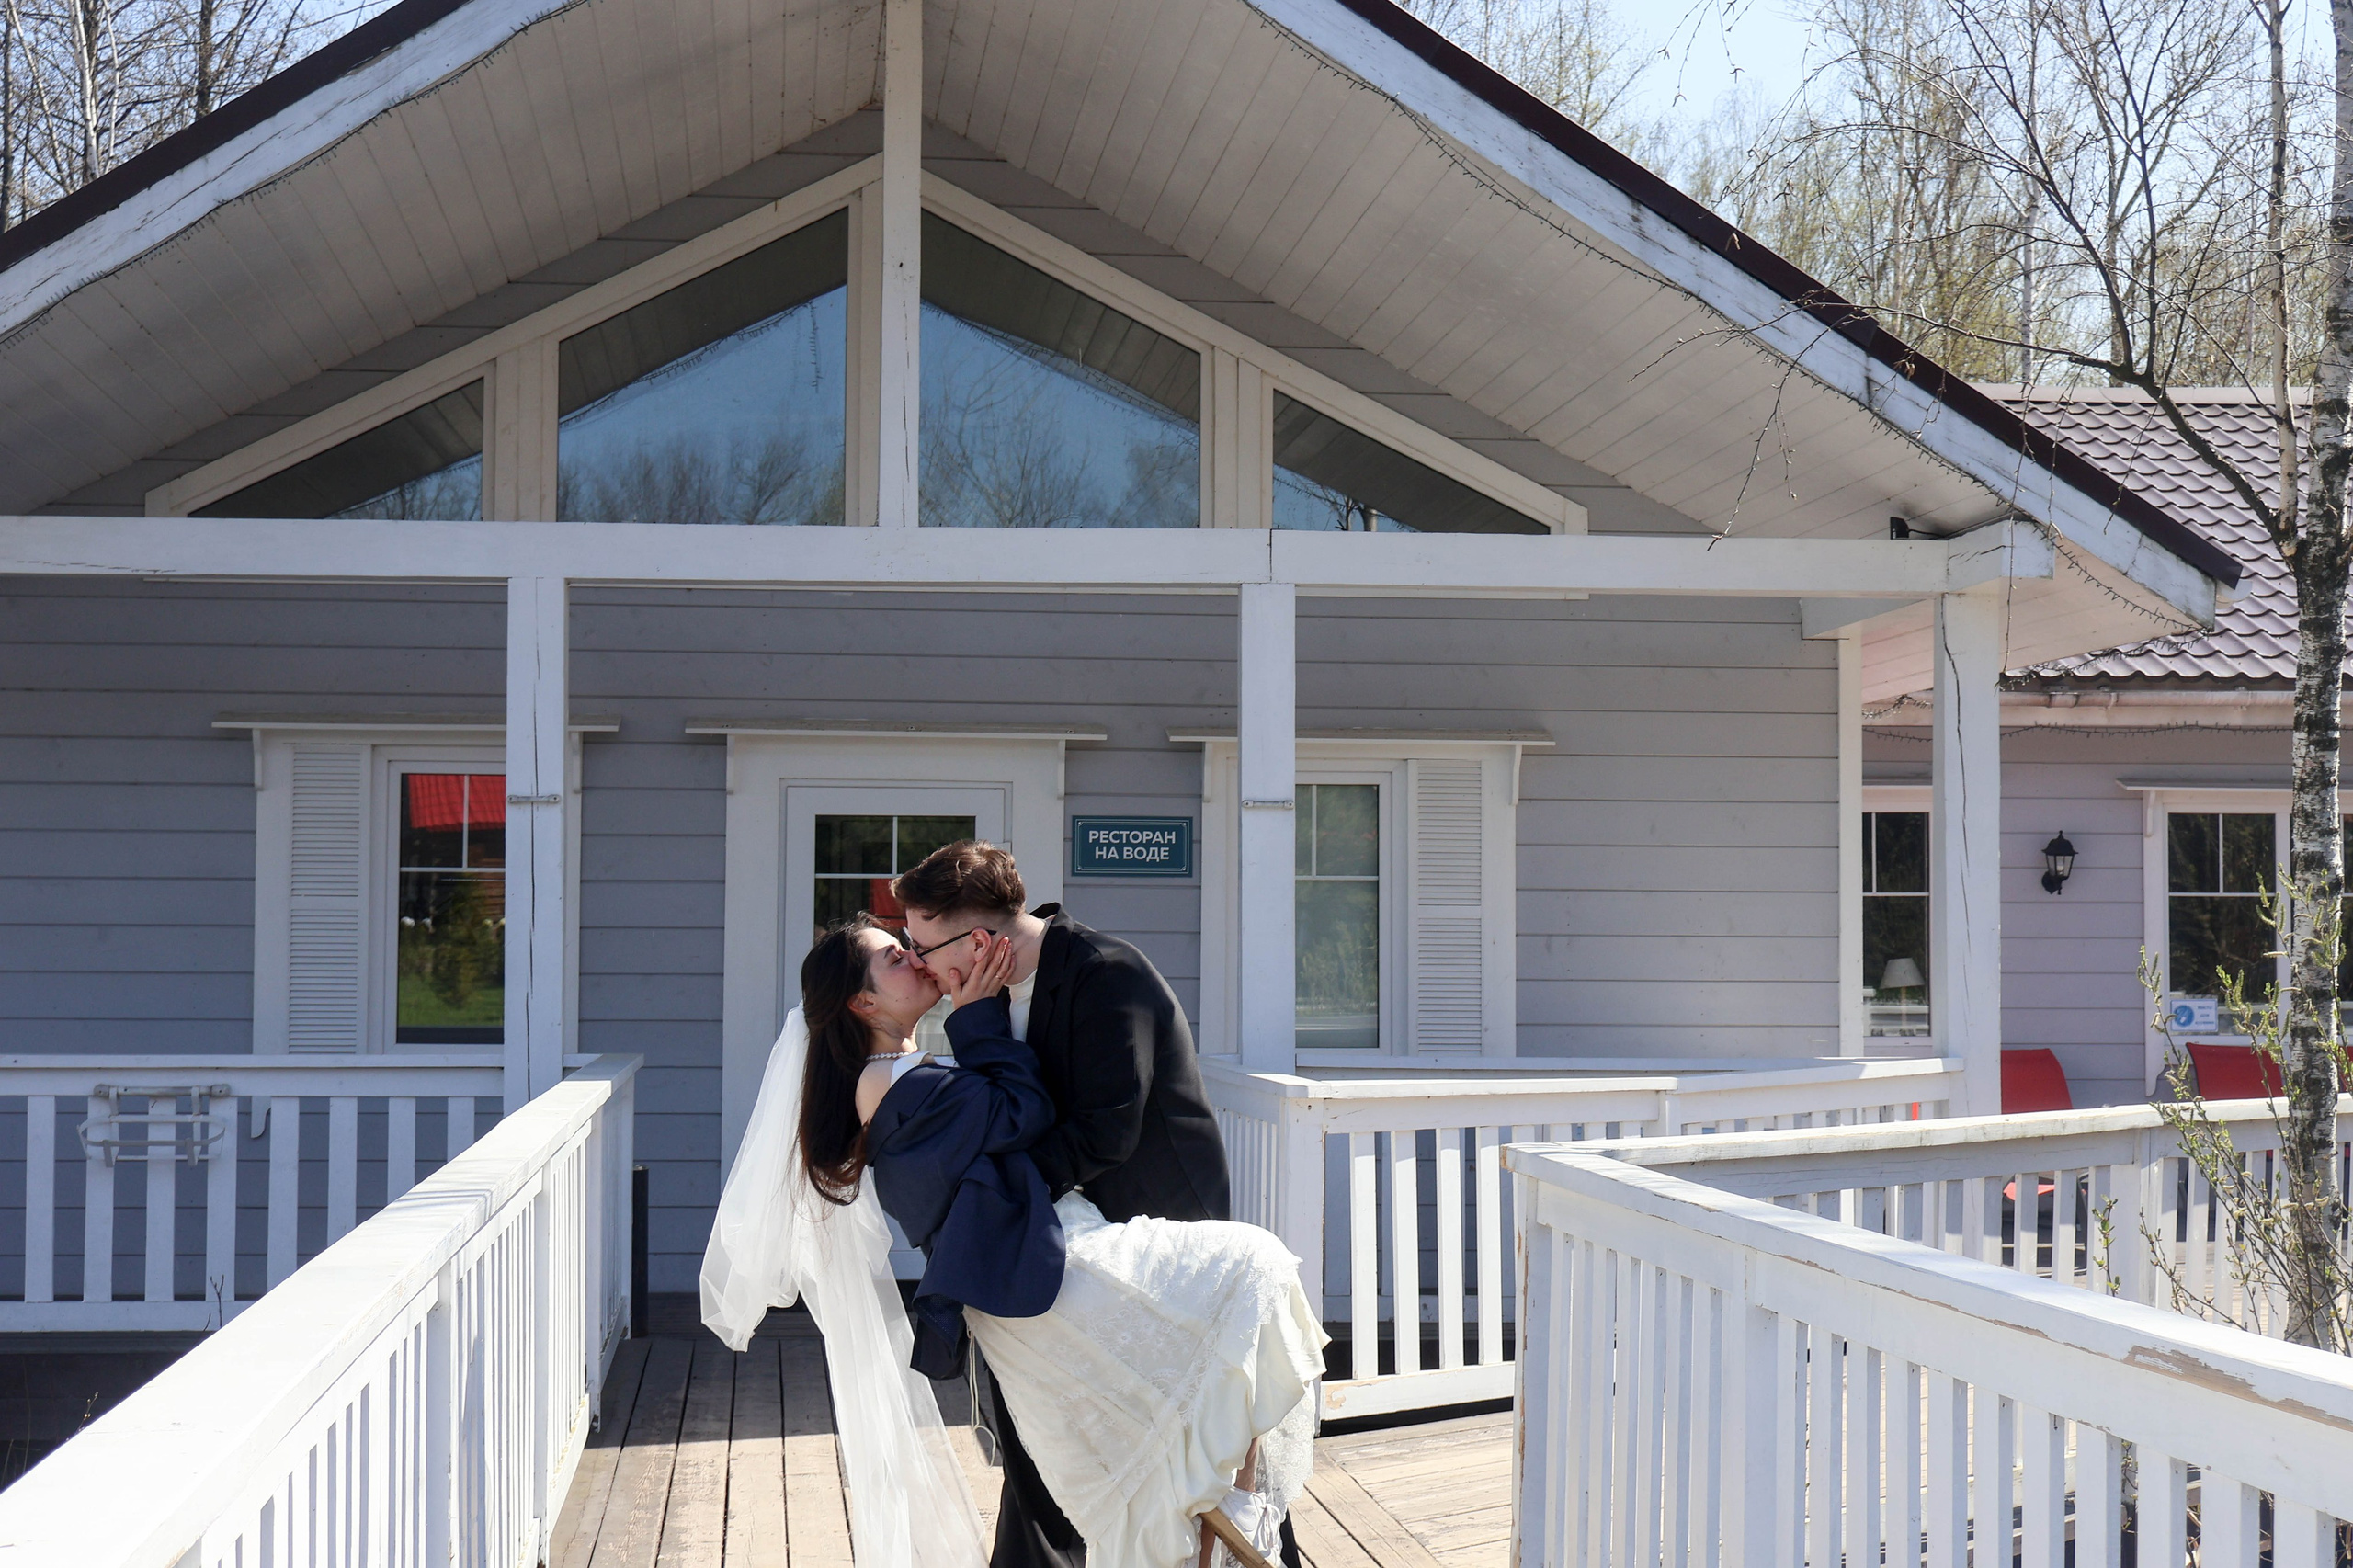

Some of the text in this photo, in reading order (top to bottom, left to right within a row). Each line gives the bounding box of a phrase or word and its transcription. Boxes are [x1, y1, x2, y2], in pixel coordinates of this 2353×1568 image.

[1088, 830, 1176, 845] РЕСТОРАН
[1095, 846, 1170, 863] НА ВОДЕ
